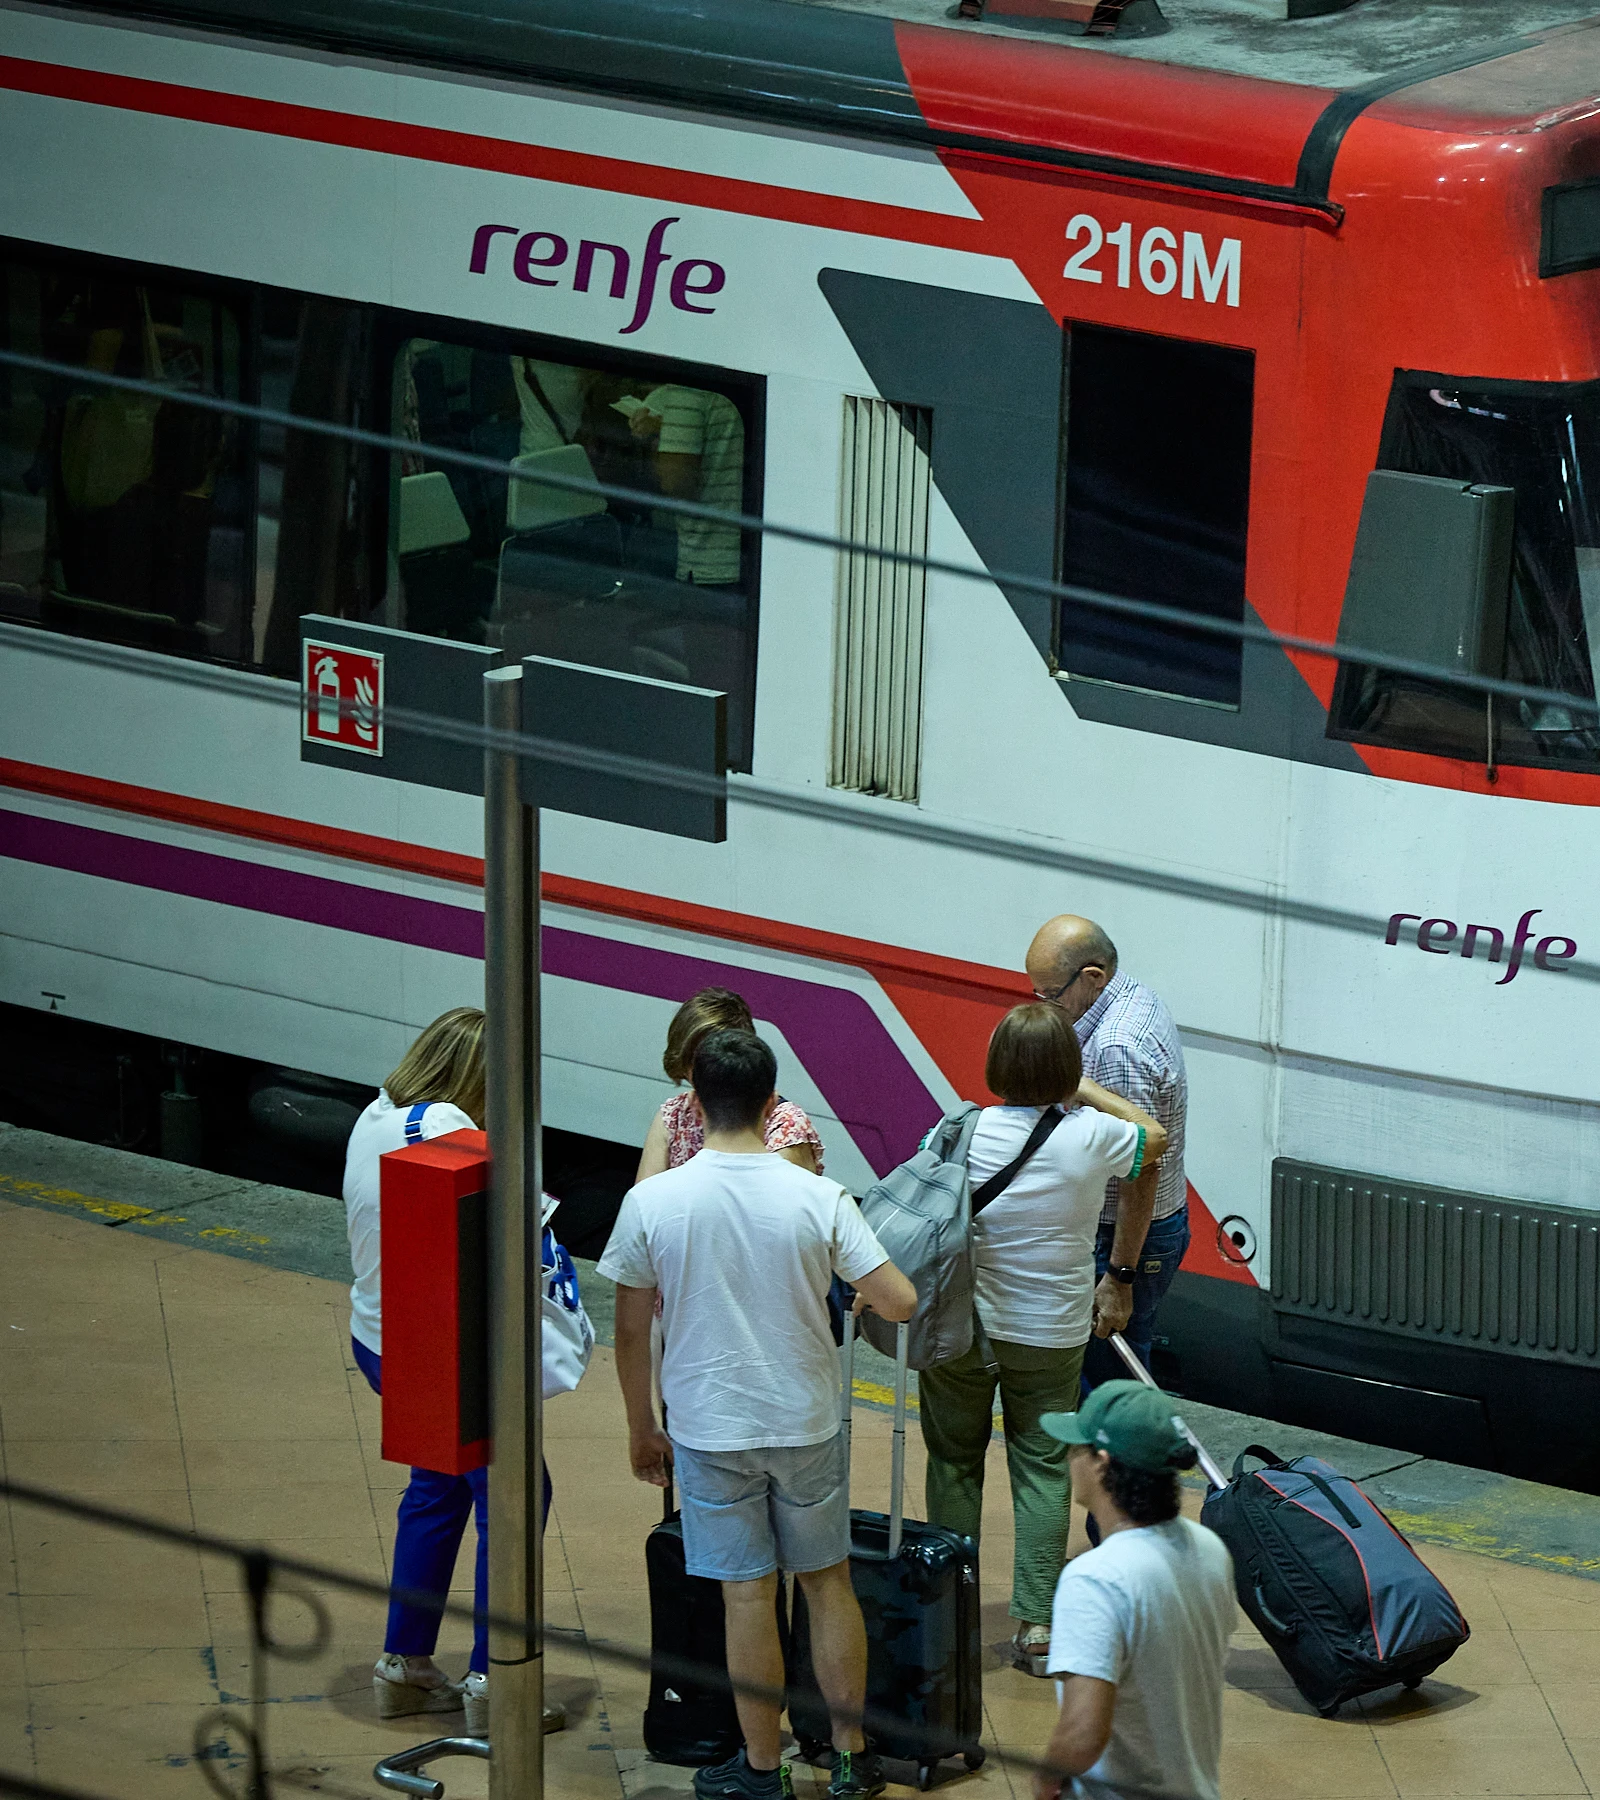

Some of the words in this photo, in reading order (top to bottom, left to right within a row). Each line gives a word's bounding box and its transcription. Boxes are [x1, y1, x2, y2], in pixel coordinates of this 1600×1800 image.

[470, 218, 726, 334] renfe
[1063, 213, 1242, 308] 216M
[1385, 909, 1578, 985] renfe
